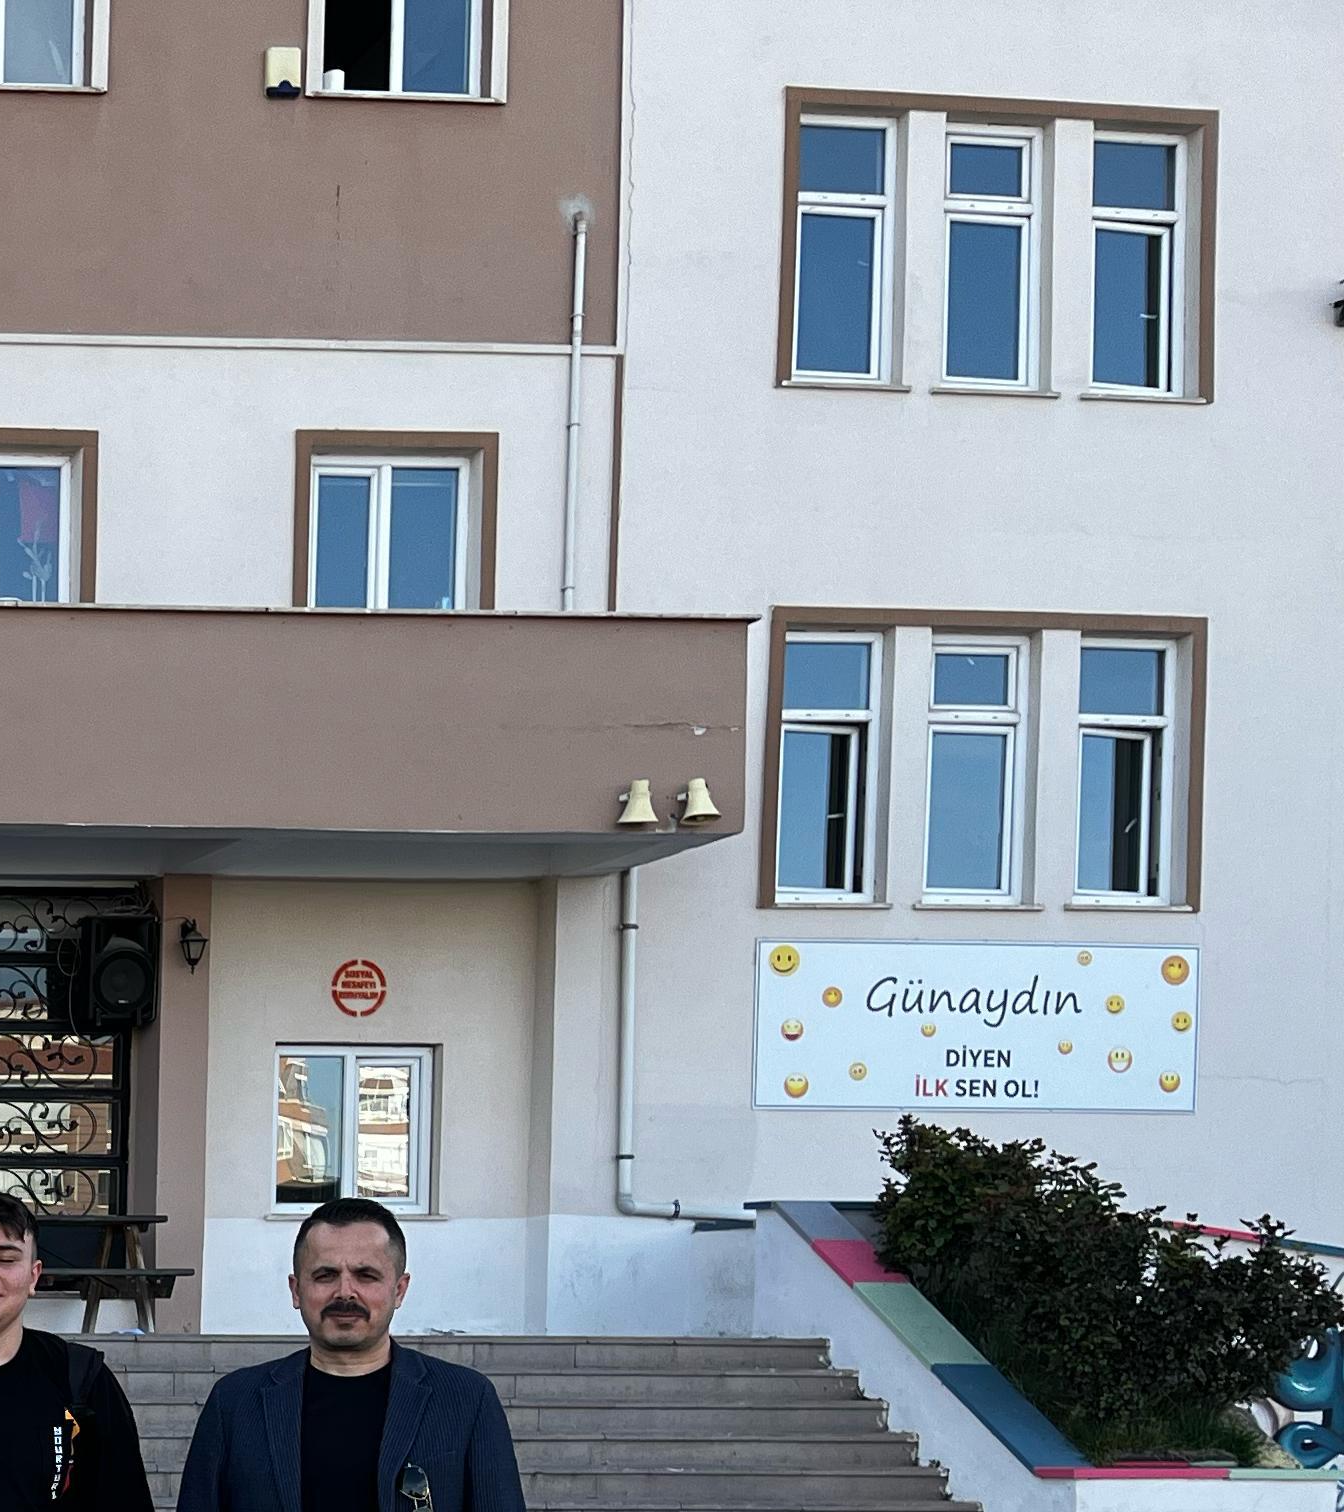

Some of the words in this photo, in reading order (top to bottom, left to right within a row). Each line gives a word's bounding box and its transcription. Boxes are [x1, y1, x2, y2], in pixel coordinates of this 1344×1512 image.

[865, 974, 1083, 1028] Günaydın
[944, 1045, 1012, 1068] DİYEN
[914, 1073, 949, 1098] İLK
[955, 1079, 997, 1098] SEN
[1003, 1079, 1039, 1099] OL!
